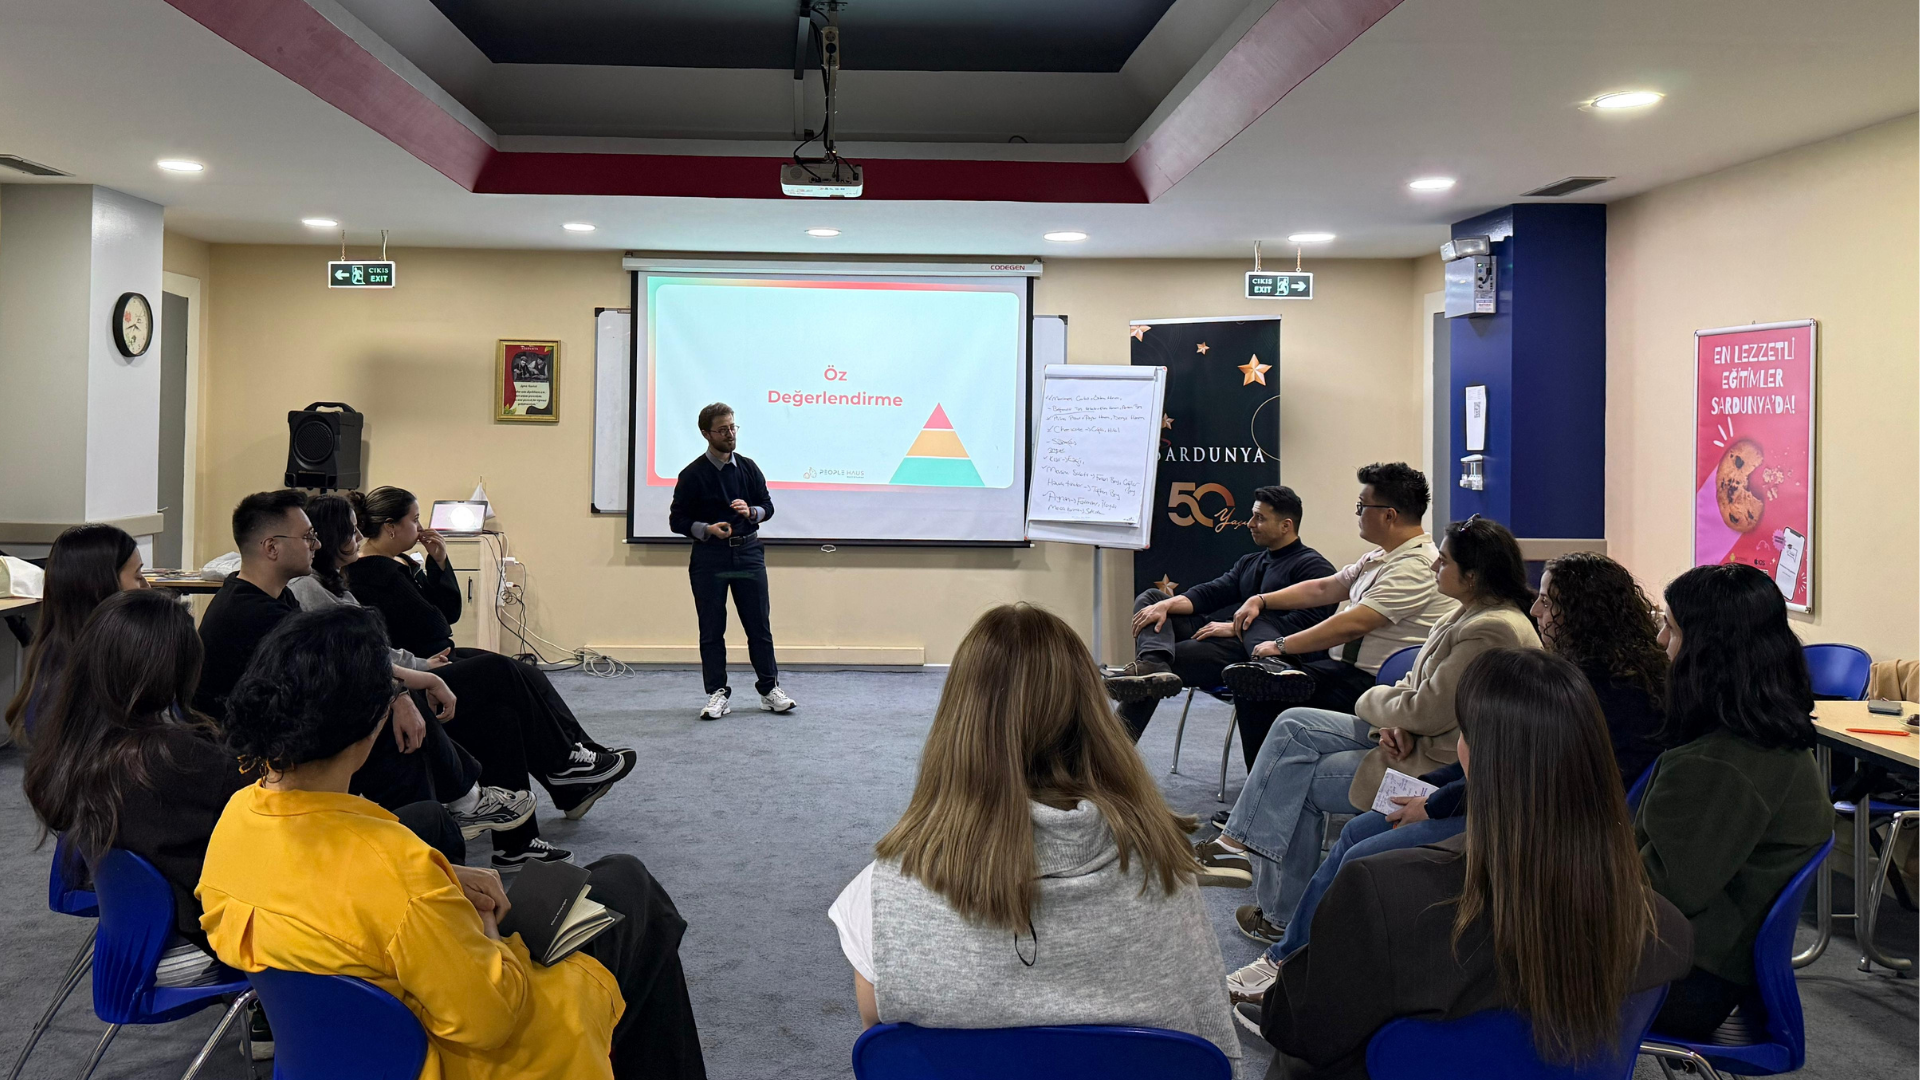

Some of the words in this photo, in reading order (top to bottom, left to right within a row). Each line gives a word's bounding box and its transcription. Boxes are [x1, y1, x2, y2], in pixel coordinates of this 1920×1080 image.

[1254, 285, 1272, 294] EXIT
[1714, 345, 1731, 364] EN
[1734, 337, 1795, 363] LEZZETLİ
[823, 364, 848, 381] Öz
[1722, 366, 1784, 389] EĞİTİMLER
[767, 389, 904, 407] Değerlendirme
[1711, 394, 1796, 415] SARDUNYA'DA!
[1157, 446, 1266, 463] ARDUNYA
[1168, 482, 1236, 528] 50
